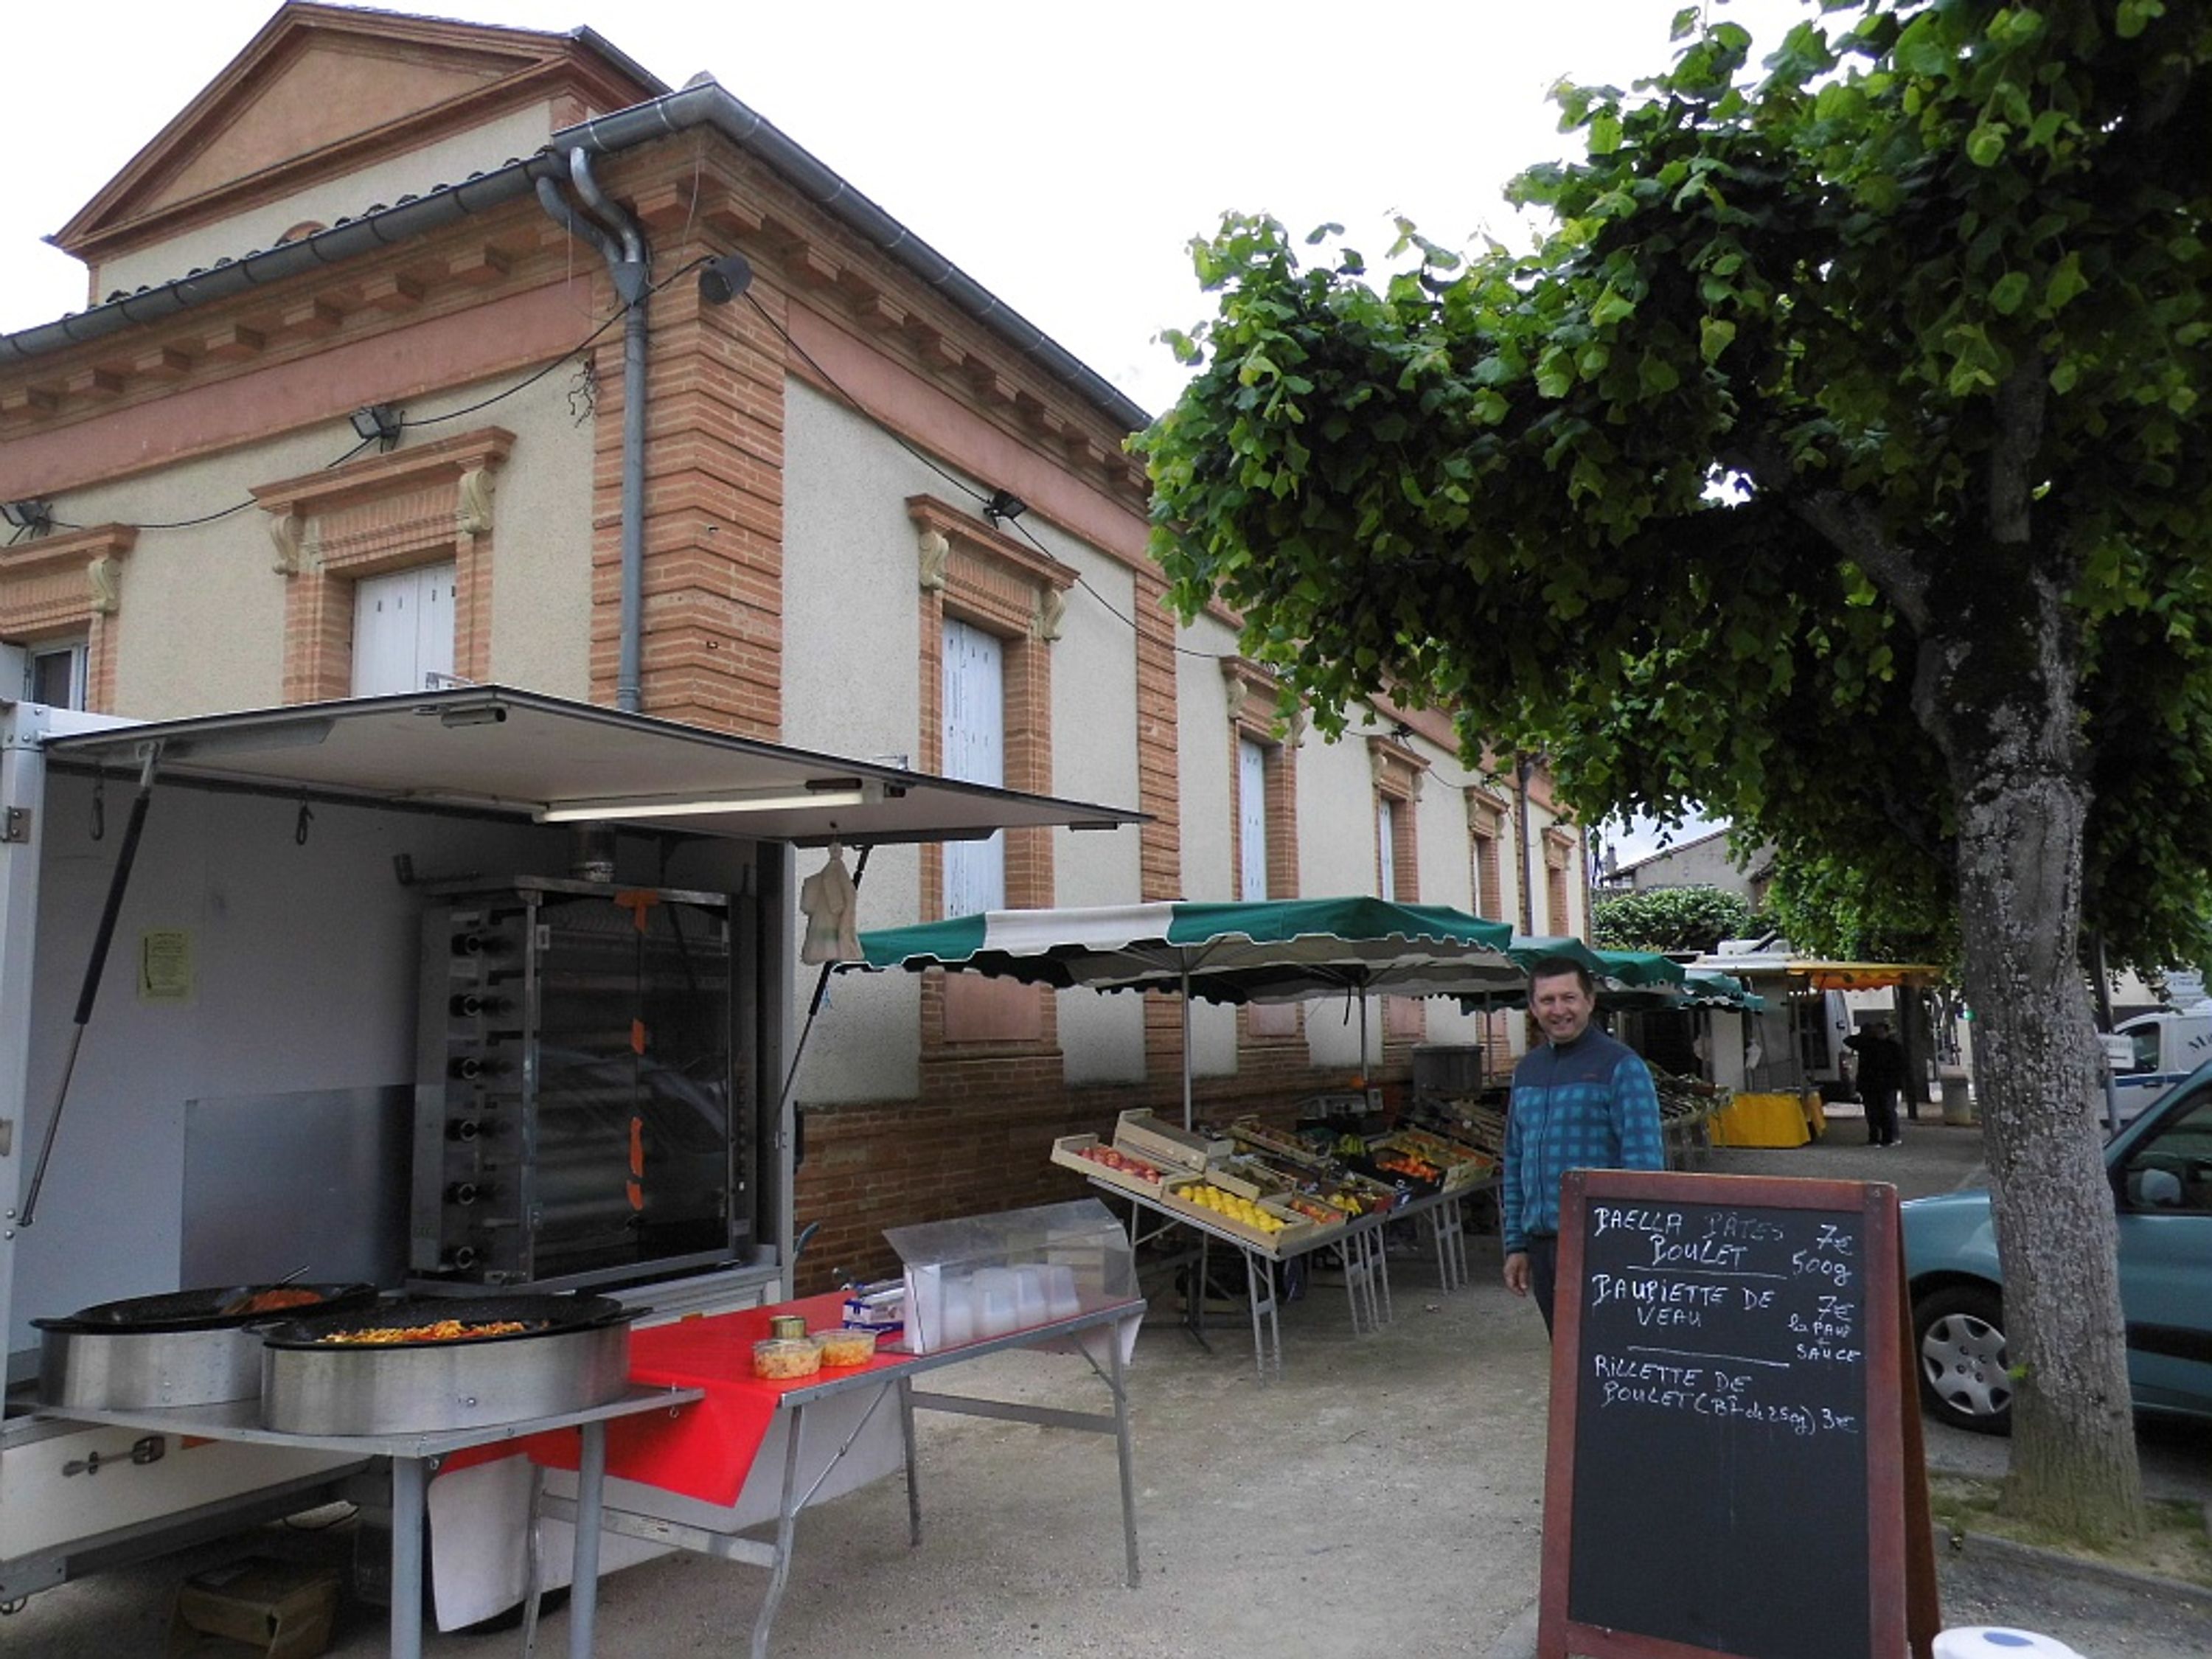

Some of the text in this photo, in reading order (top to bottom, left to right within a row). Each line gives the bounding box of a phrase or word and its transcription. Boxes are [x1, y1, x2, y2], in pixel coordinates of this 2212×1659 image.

[1593, 1207, 1683, 1237] PAELLA
[1649, 1233, 1747, 1270] POULET
[1816, 1224, 1853, 1256] 7€
[1792, 1249, 1852, 1286] 500g
[1742, 1287, 1775, 1310] DE
[1818, 1295, 1854, 1322] 7€
[1637, 1306, 1701, 1327] VEAU
[1796, 1343, 1862, 1363] SAUCE
[1601, 1380, 1694, 1409] POULET
[1715, 1371, 1753, 1392] DE
